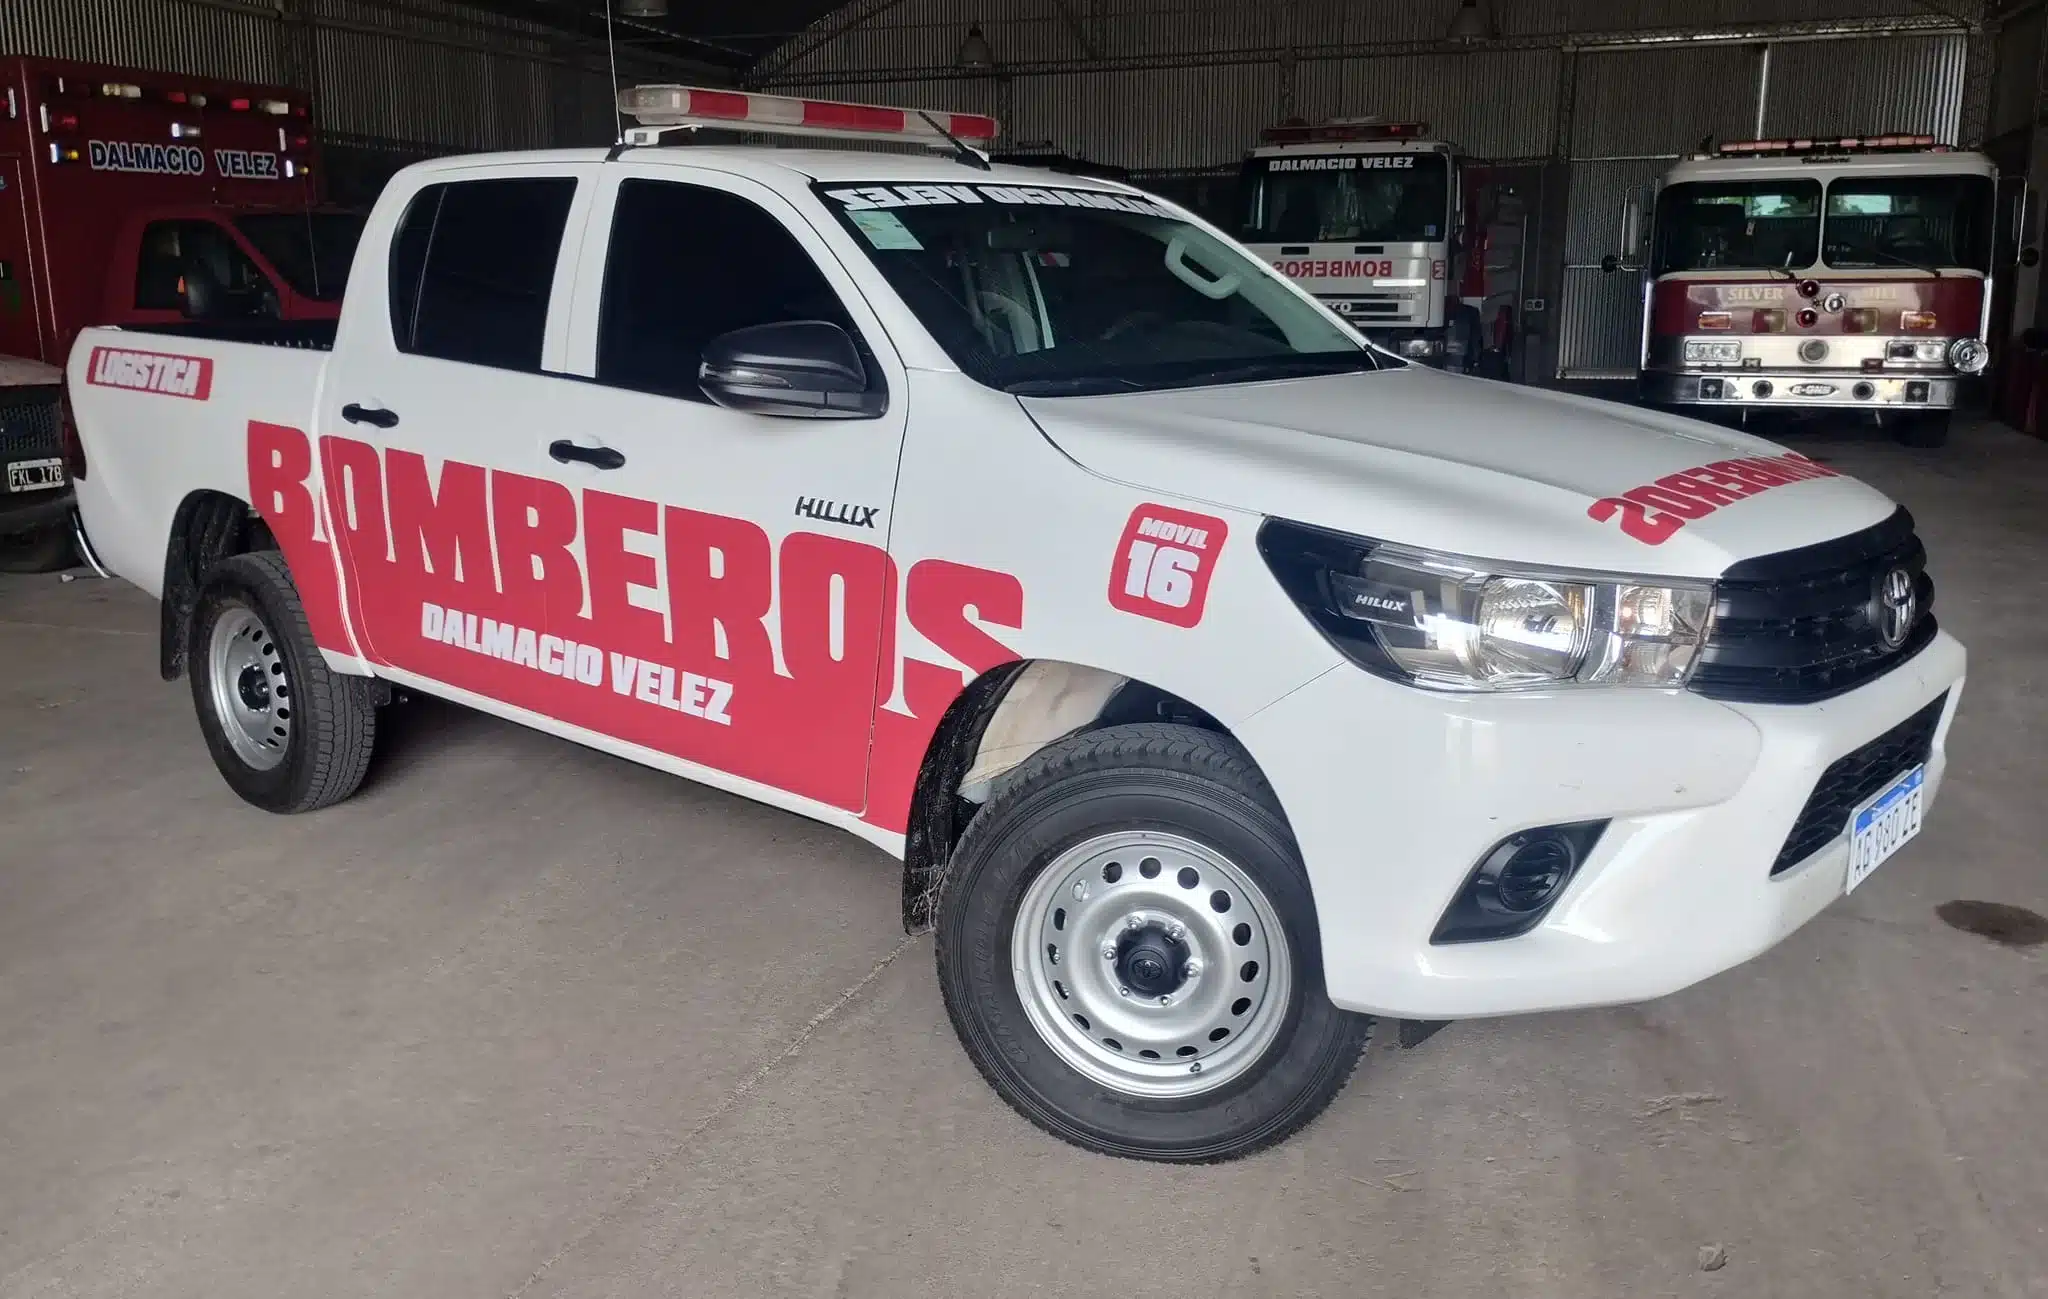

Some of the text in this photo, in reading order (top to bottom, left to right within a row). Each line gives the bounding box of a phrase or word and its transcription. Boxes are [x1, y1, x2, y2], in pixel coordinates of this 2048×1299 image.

[89, 140, 280, 179] DALMACIO VELEZ
[1269, 157, 1414, 172] DALMACIO VELEZ
[1727, 286, 1784, 301] SILVER
[94, 350, 201, 396] LOGISTICA
[11, 467, 33, 486] FKL
[795, 496, 880, 529] HILUX
[1137, 517, 1208, 550] MOVIL
[247, 420, 1025, 718] BOMBEROS
[1125, 540, 1200, 608] 16
[1355, 594, 1406, 612] HILUX
[421, 602, 734, 726] DALMACIO VELEZ
[1902, 791, 1918, 837] ZE
